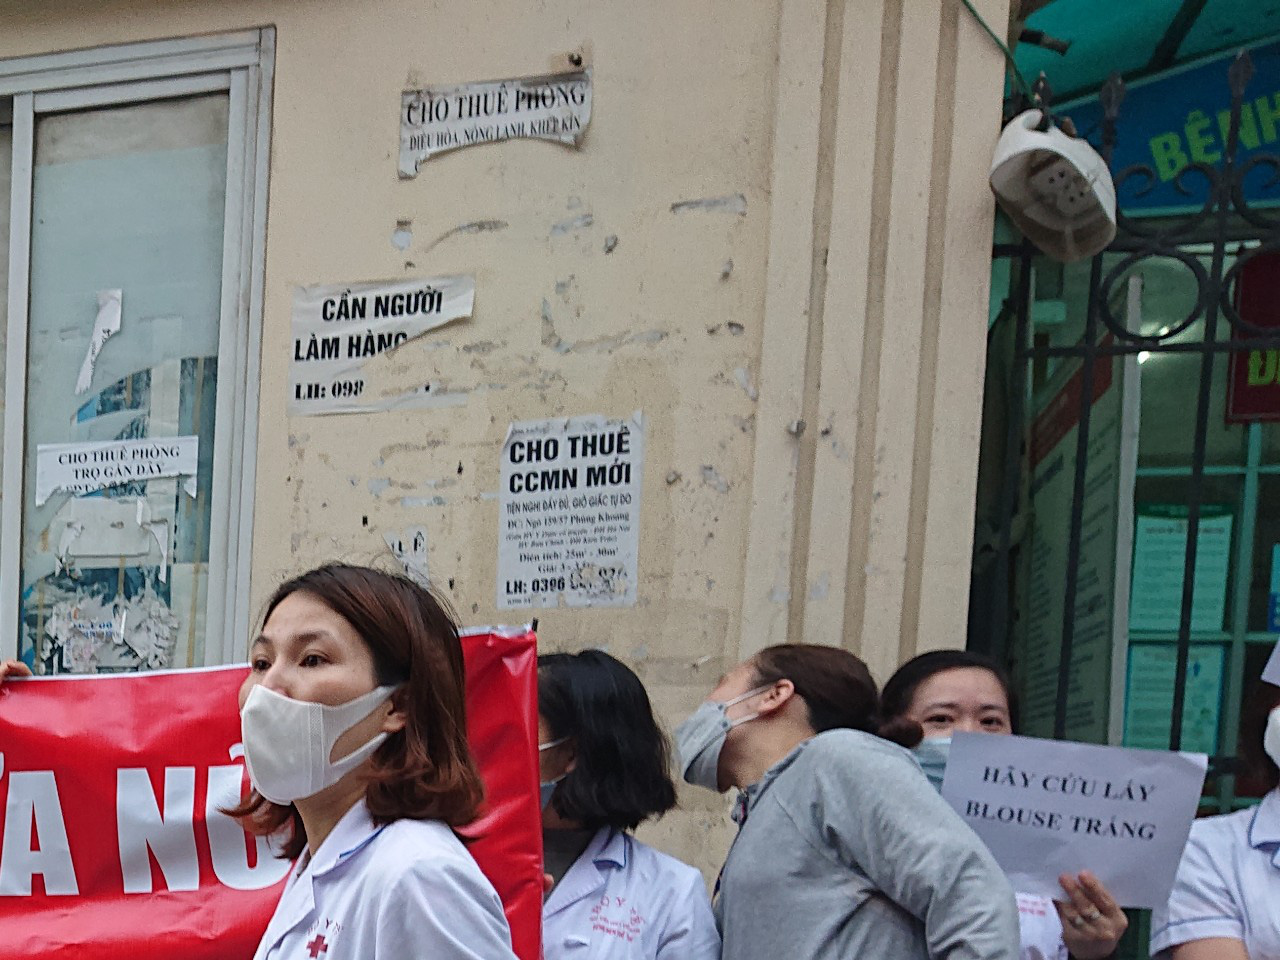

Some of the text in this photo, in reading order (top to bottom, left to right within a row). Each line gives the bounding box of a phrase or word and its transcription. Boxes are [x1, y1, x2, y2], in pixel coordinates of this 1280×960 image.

[407, 82, 586, 126] CHO THUÊ PHÒNG
[322, 285, 444, 321] CẦN NGƯỜI
[294, 333, 340, 361] LÀM
[58, 444, 181, 467] CHO THUÊ PHÒNG
[509, 425, 631, 464] CHO THUÊ
[72, 467, 101, 482] TRỌ
[509, 457, 632, 493] CCMN MỚI
[981, 764, 1036, 789] HÃY
[1041, 772, 1097, 799] CỨU
[965, 800, 1062, 831] BLOUSE
